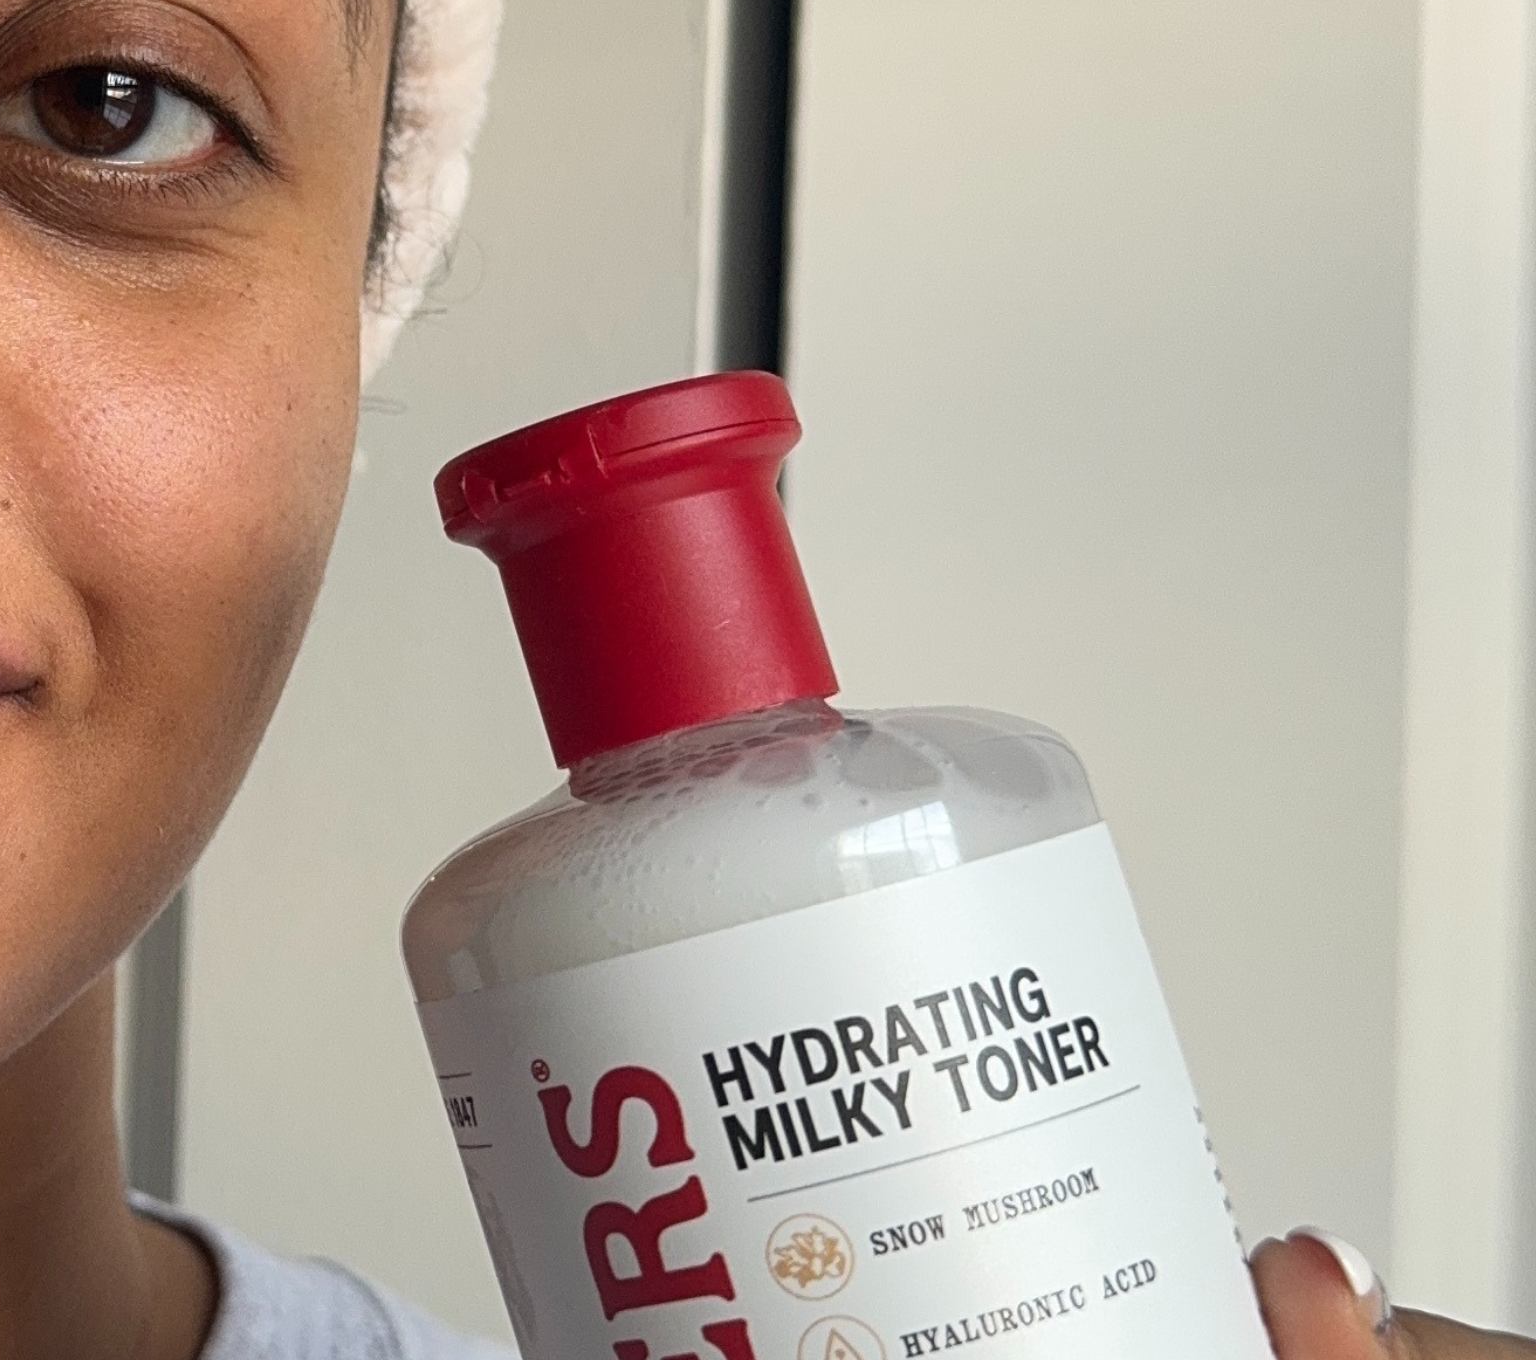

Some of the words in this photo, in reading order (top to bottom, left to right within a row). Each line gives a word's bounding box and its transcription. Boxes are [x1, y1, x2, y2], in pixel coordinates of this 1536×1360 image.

[702, 967, 1051, 1108] HYDRATING
[722, 1069, 912, 1171] MILKY
[932, 1016, 1110, 1113] TONER
[869, 1215, 945, 1256] SNOW
[962, 1167, 1099, 1231] MUSHROOM
[900, 1285, 1085, 1358] HYALURONIC
[1103, 1259, 1156, 1299] ACID
